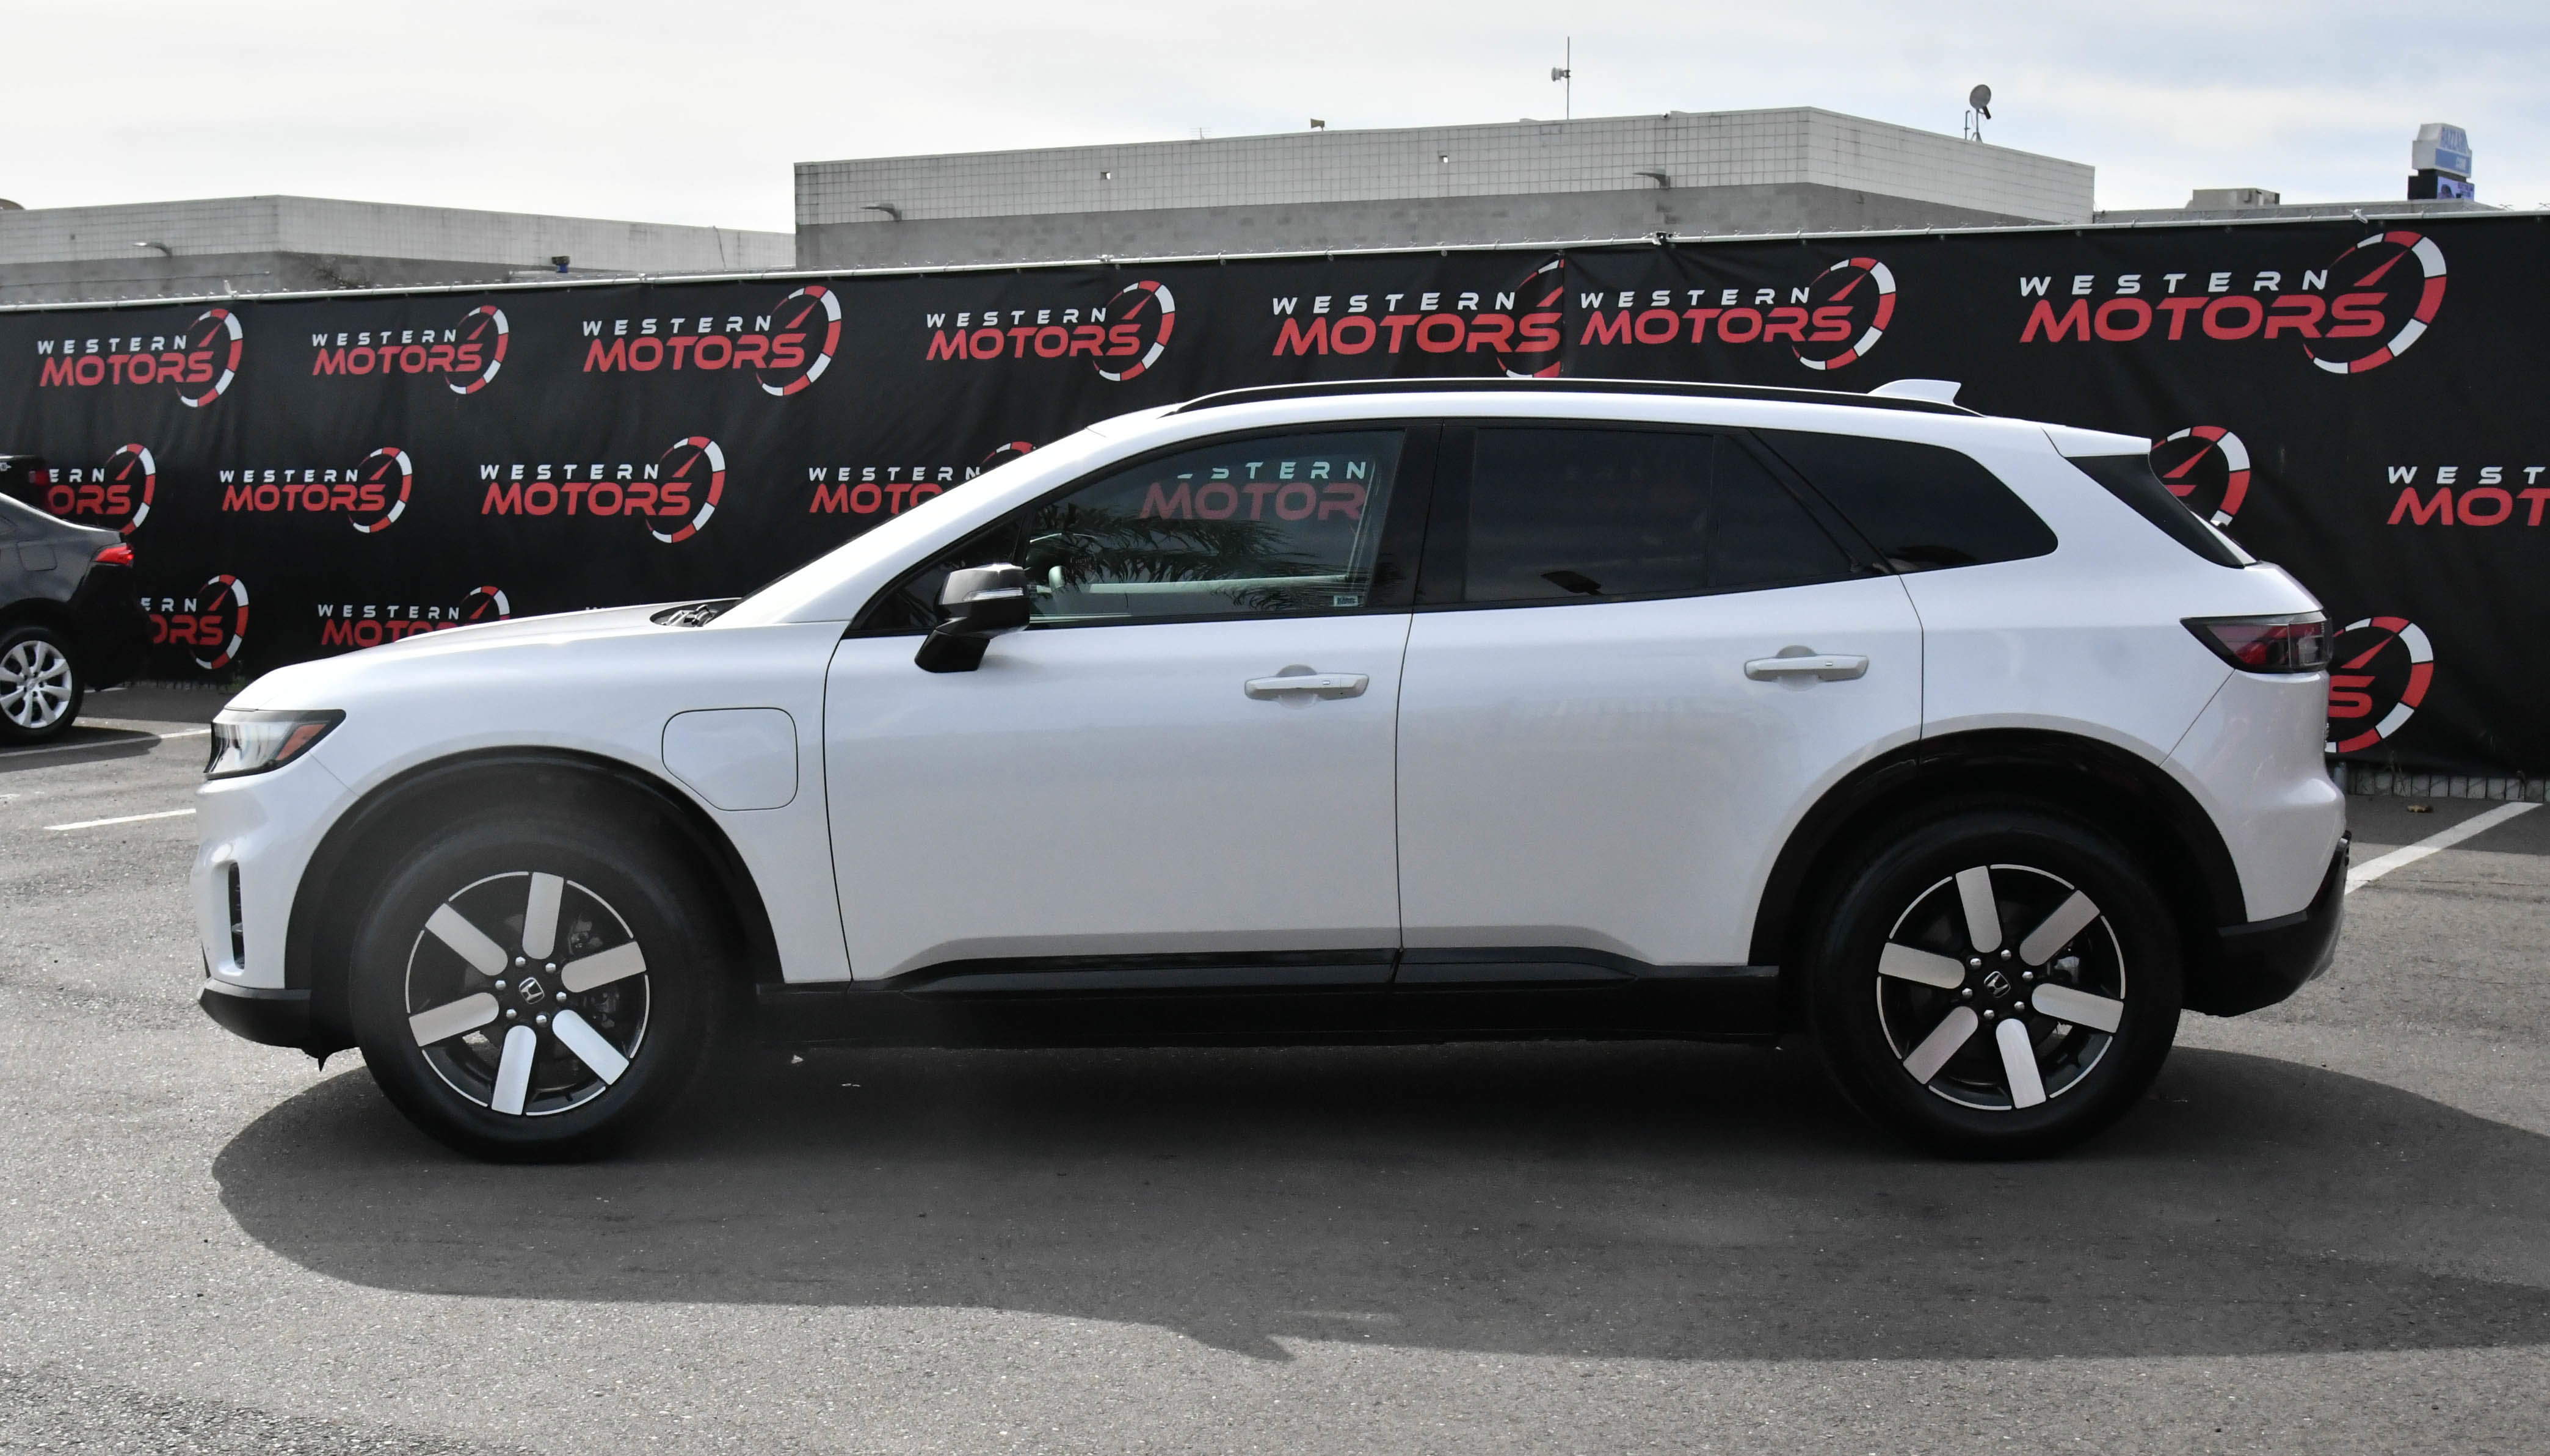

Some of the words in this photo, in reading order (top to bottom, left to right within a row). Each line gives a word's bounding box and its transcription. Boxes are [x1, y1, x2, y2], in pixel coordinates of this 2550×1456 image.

[2021, 270, 2327, 296] WESTERN
[1273, 292, 1515, 315] WESTERN
[1581, 288, 1809, 308] WESTERN
[583, 316, 771, 336] WESTERN
[927, 308, 1106, 328] WESTERN
[1580, 306, 1853, 345] MOTORS
[2021, 292, 2387, 342] MOTORS
[38, 335, 186, 354] WESTERN
[313, 330, 456, 346] WESTERN
[926, 324, 1141, 360] MOTORS
[1273, 313, 1562, 355] MOTORS
[313, 343, 482, 375] MOTORS
[584, 333, 806, 372] MOTORS
[41, 351, 213, 386] MOTORS
[220, 469, 357, 482] WESTERN
[481, 464, 658, 479] WESTERN
[809, 467, 982, 484] WESTERN
[1178, 462, 1365, 479] STERN
[2389, 466, 2545, 484] WEST
[48, 485, 131, 514] ORS
[222, 484, 385, 511] MOTORS
[482, 482, 691, 516] MOTORS
[1139, 482, 1368, 521] MOTOR
[2388, 487, 2550, 526] MOT
[319, 605, 459, 619] WESTERN
[151, 615, 222, 645] ORS
